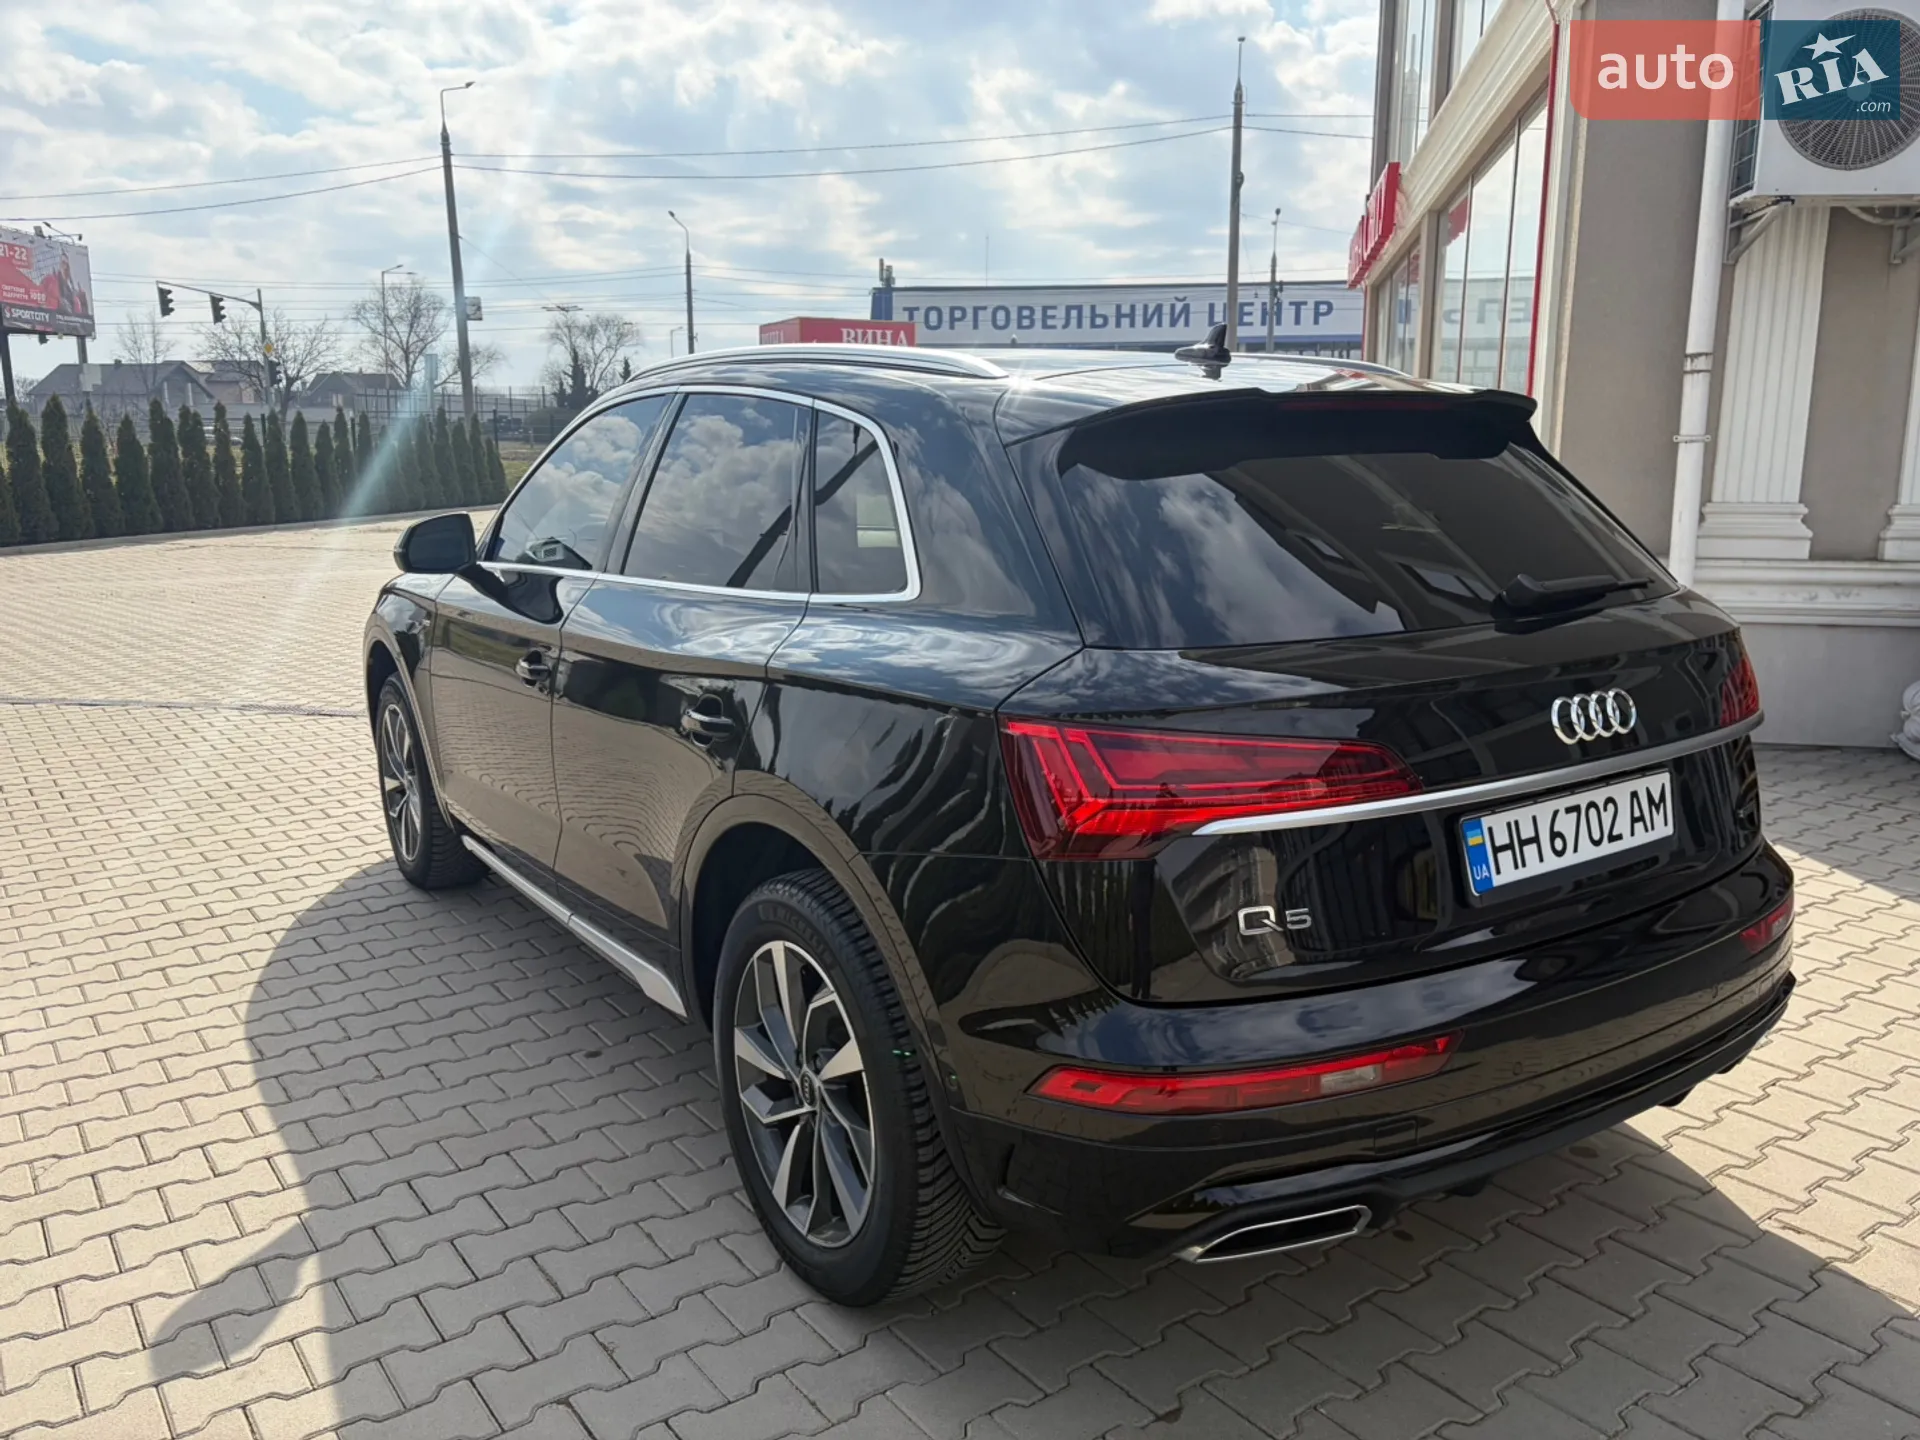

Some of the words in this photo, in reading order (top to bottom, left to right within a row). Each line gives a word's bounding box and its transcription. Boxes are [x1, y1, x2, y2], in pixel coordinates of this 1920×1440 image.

[902, 296, 1191, 331] ТОРГОВЕЛЬНИЙ
[1207, 300, 1334, 328] ЦЕНТР
[840, 328, 909, 347] ВИНА
[1487, 815, 1544, 875] HH
[1549, 796, 1623, 858] 6702
[1629, 782, 1668, 837] AM
[1473, 864, 1490, 881] UA
[1237, 905, 1312, 936] Q5
